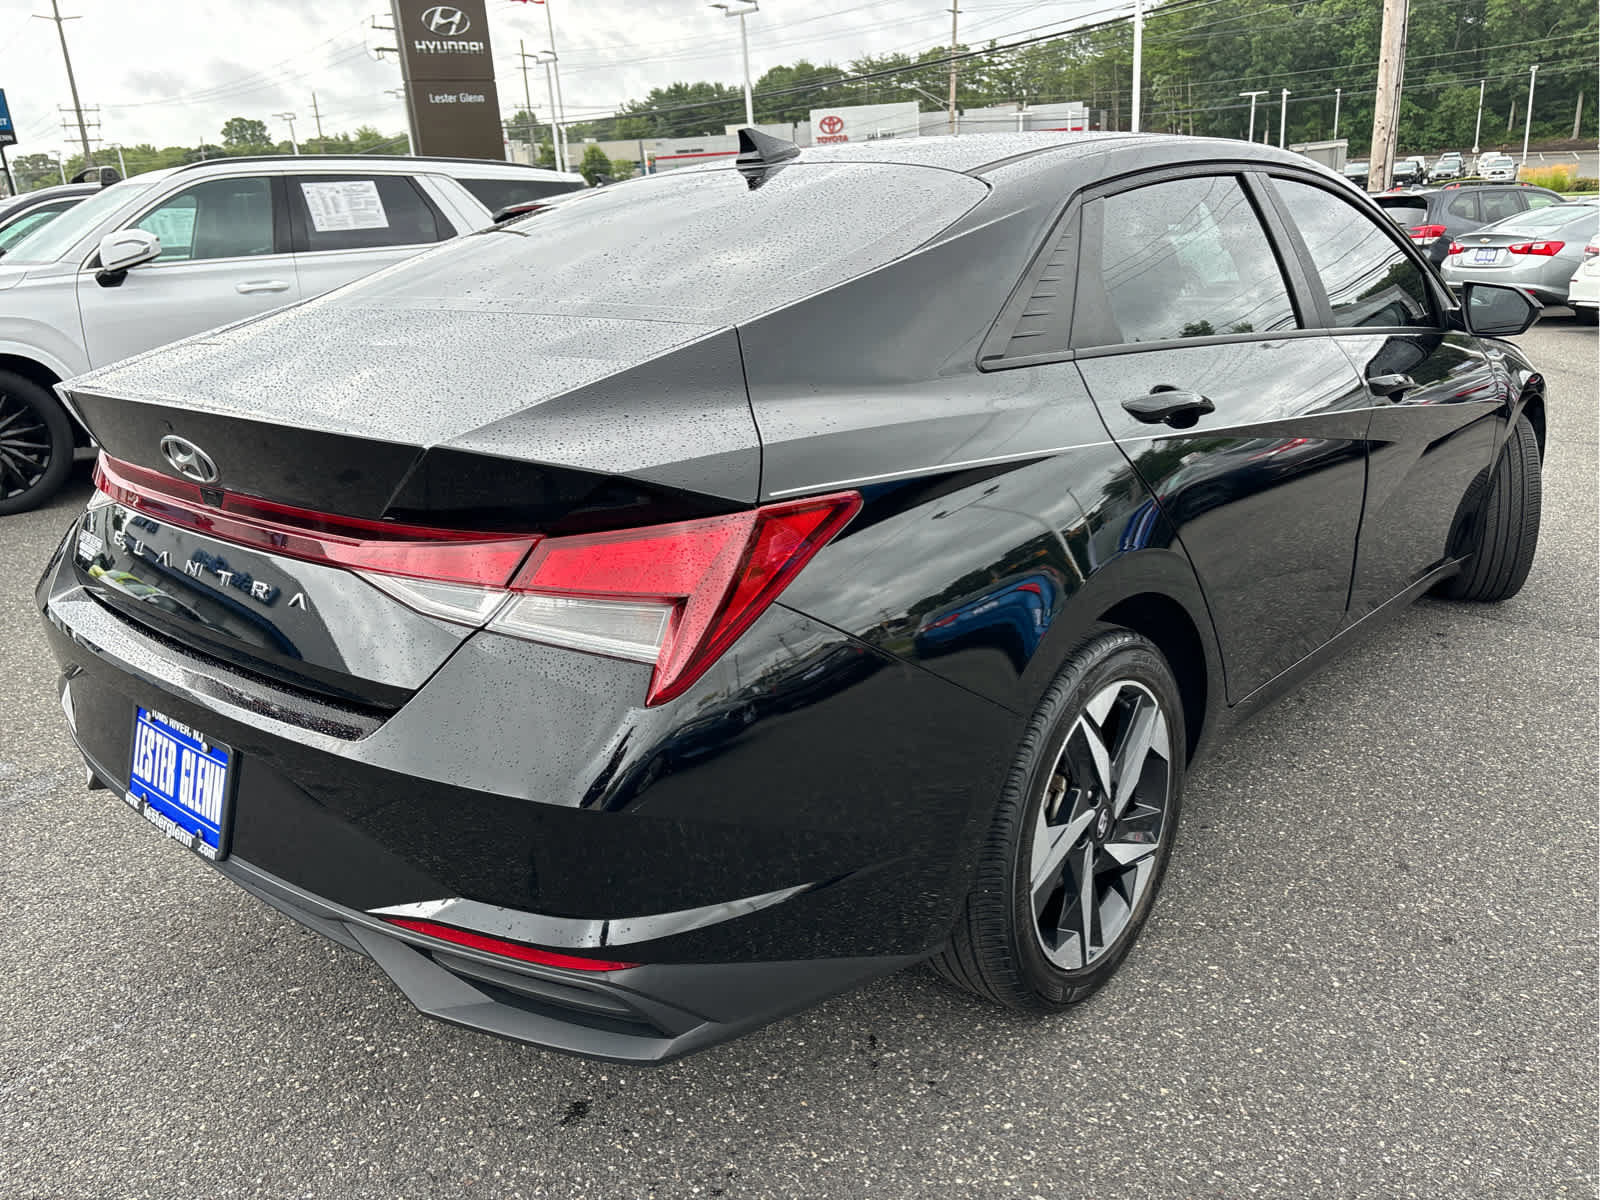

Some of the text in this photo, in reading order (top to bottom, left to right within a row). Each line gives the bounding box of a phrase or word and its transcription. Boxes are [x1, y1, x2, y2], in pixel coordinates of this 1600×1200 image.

[415, 40, 484, 54] HYUNDAI
[429, 93, 485, 103] Lester Glenn
[816, 135, 848, 144] TOYOTA
[114, 530, 306, 611] ELANTRA
[133, 721, 226, 826] LESTER GLENN
[143, 803, 193, 847] lesterglenn
